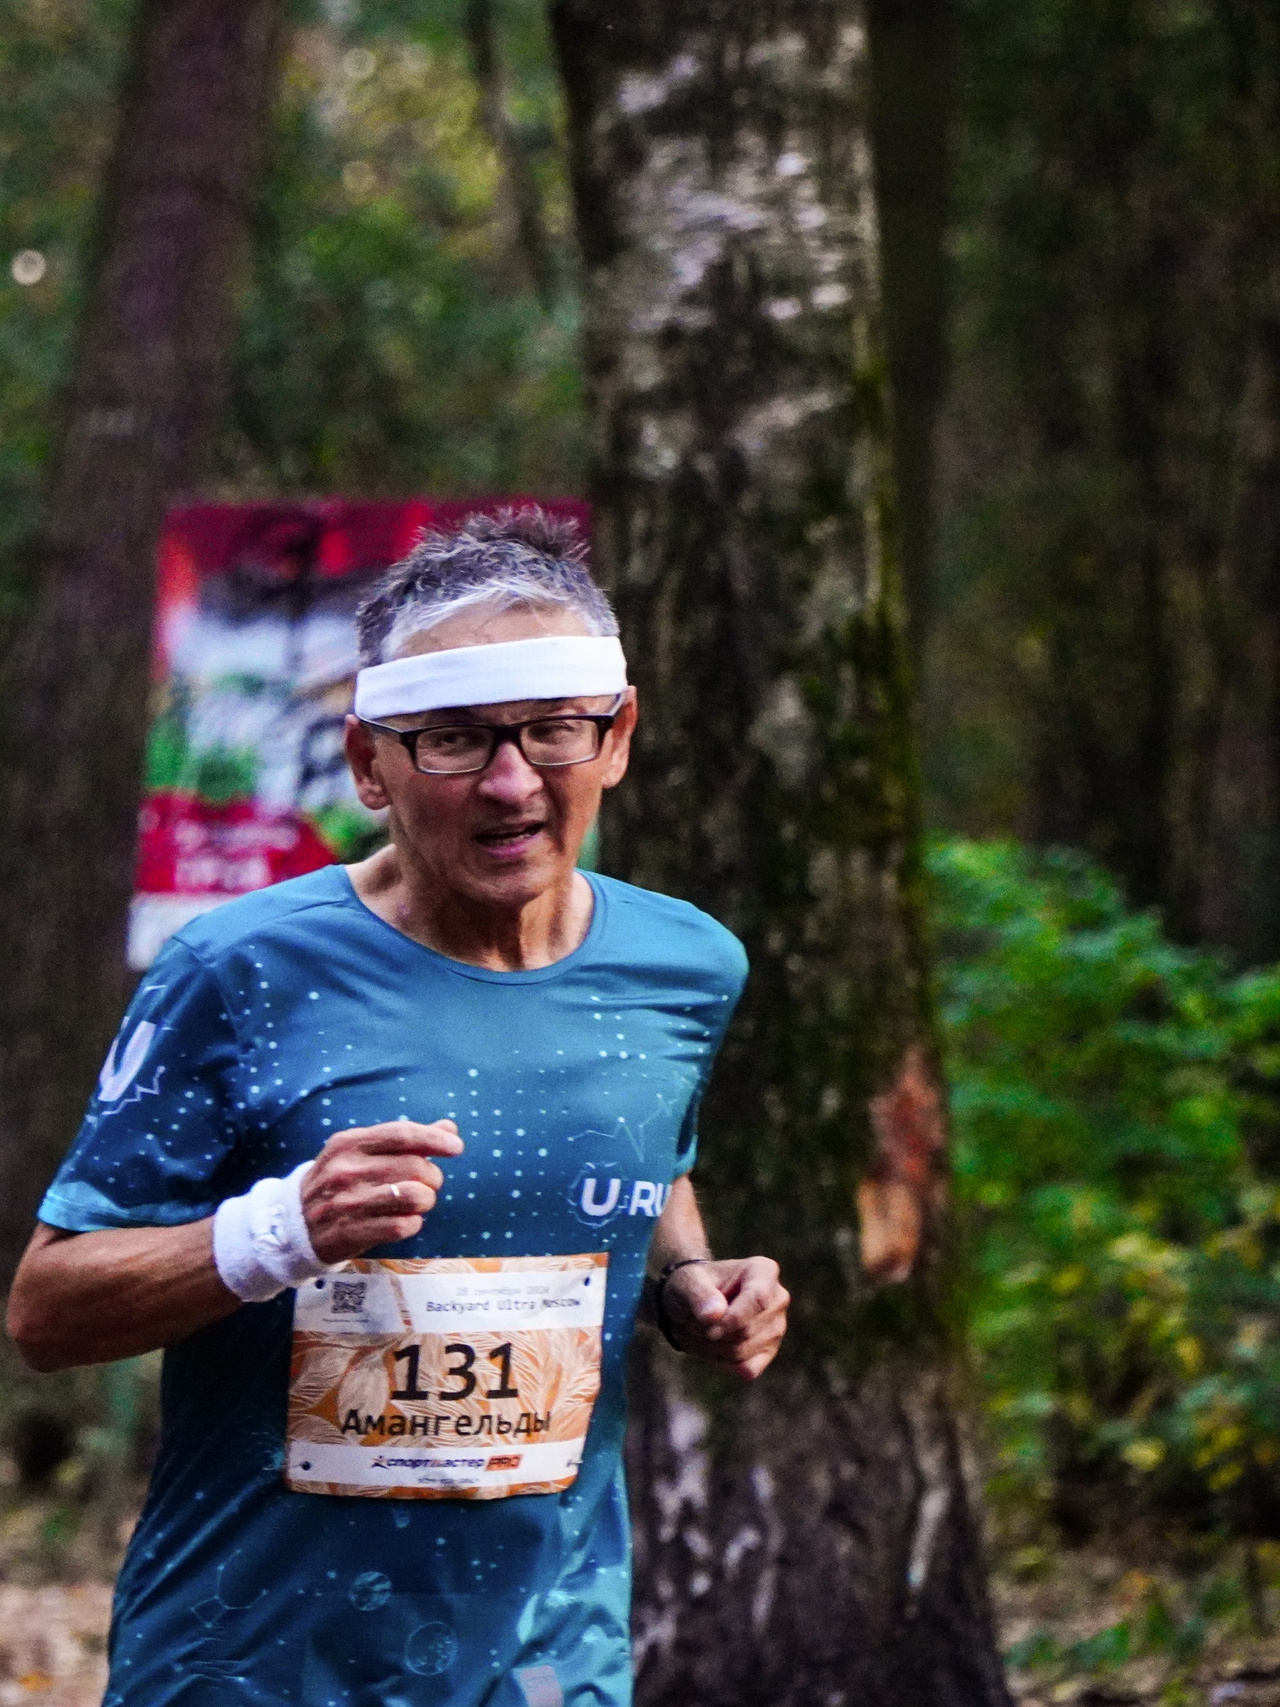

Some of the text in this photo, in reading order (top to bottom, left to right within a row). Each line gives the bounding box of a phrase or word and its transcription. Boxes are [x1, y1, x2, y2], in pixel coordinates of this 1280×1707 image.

[426, 1300, 489, 1314] Backyard
[497, 1299, 536, 1311] Ultra
[390, 1342, 519, 1400] 131
[340, 1408, 551, 1438] Амангельды
